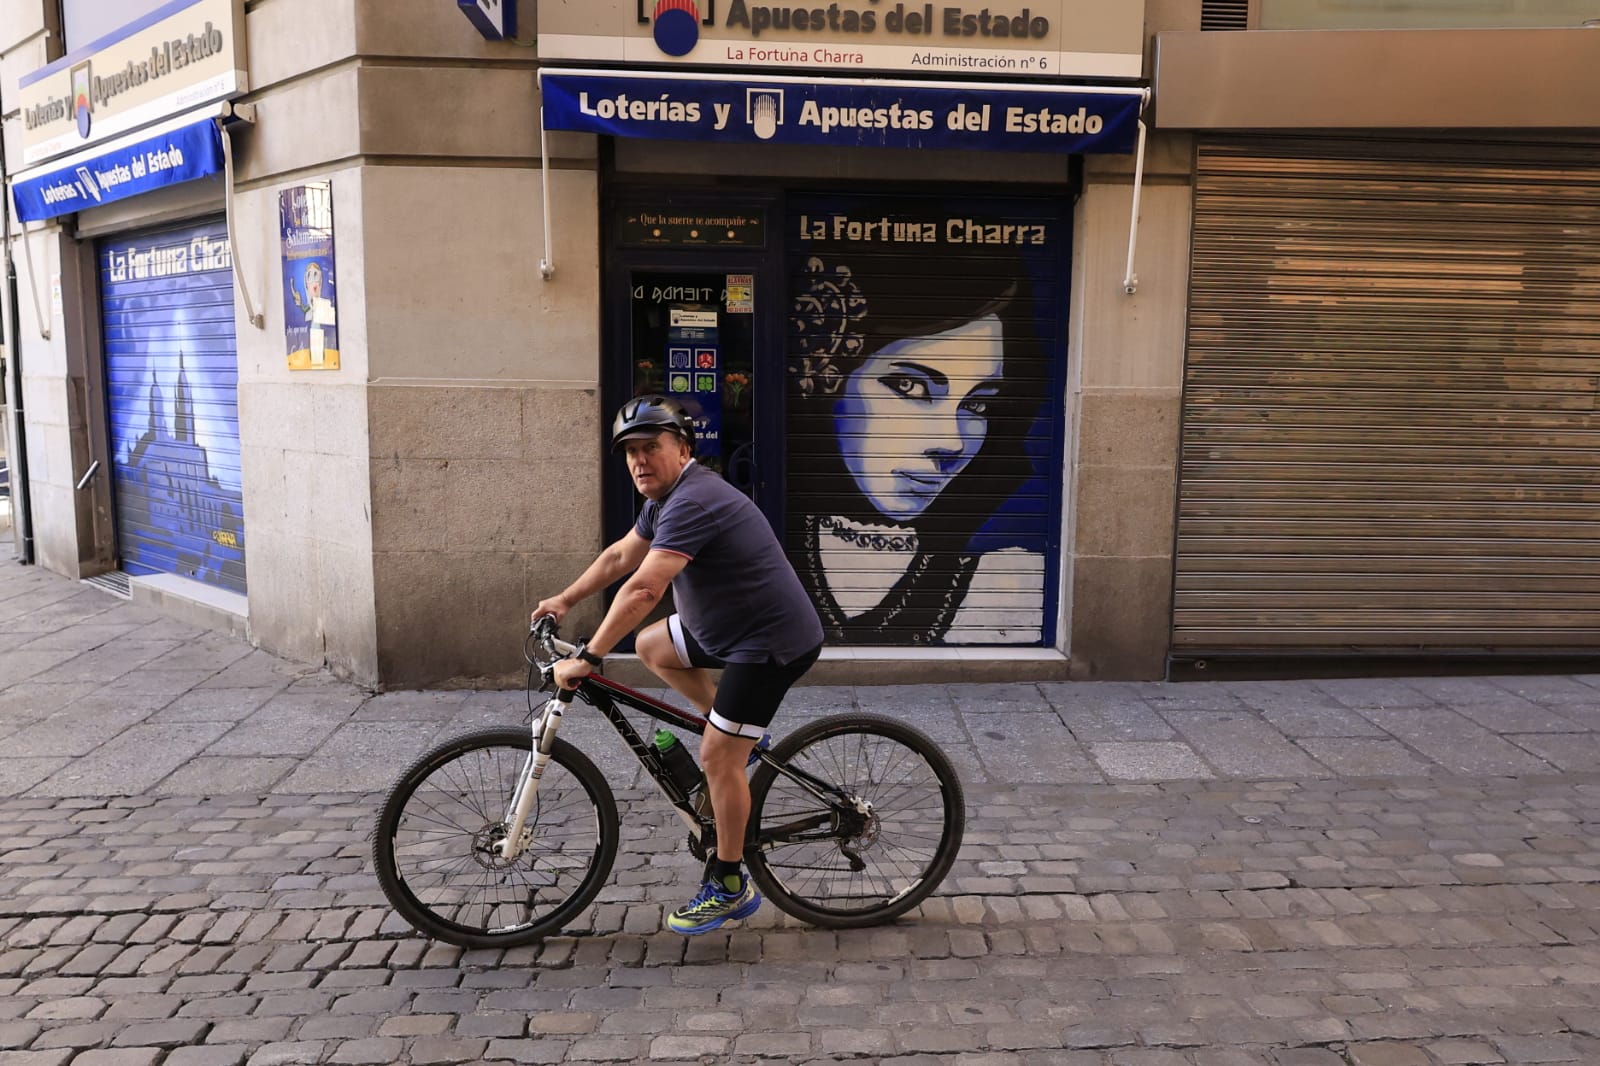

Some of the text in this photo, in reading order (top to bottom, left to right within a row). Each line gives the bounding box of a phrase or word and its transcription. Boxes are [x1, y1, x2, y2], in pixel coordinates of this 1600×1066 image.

[726, 0, 1050, 38] Apuestas del Estado
[93, 60, 148, 106] Apuestas
[149, 41, 171, 79] del
[171, 22, 222, 70] Estado
[727, 46, 864, 64] La Fortuna Charra
[911, 52, 1015, 69] Administración
[1039, 57, 1048, 69] 6
[578, 92, 1103, 134] Loterías y Apuestas del Estado
[132, 155, 146, 180] del
[148, 144, 184, 173] Estado
[640, 213, 657, 227] Que
[658, 214, 667, 224] la
[668, 216, 693, 225] suerte
[705, 215, 746, 230] acompañe
[800, 215, 1045, 245] La Fortuna Charra
[109, 235, 232, 282] La Fortuna Char
[706, 431, 718, 439] del
